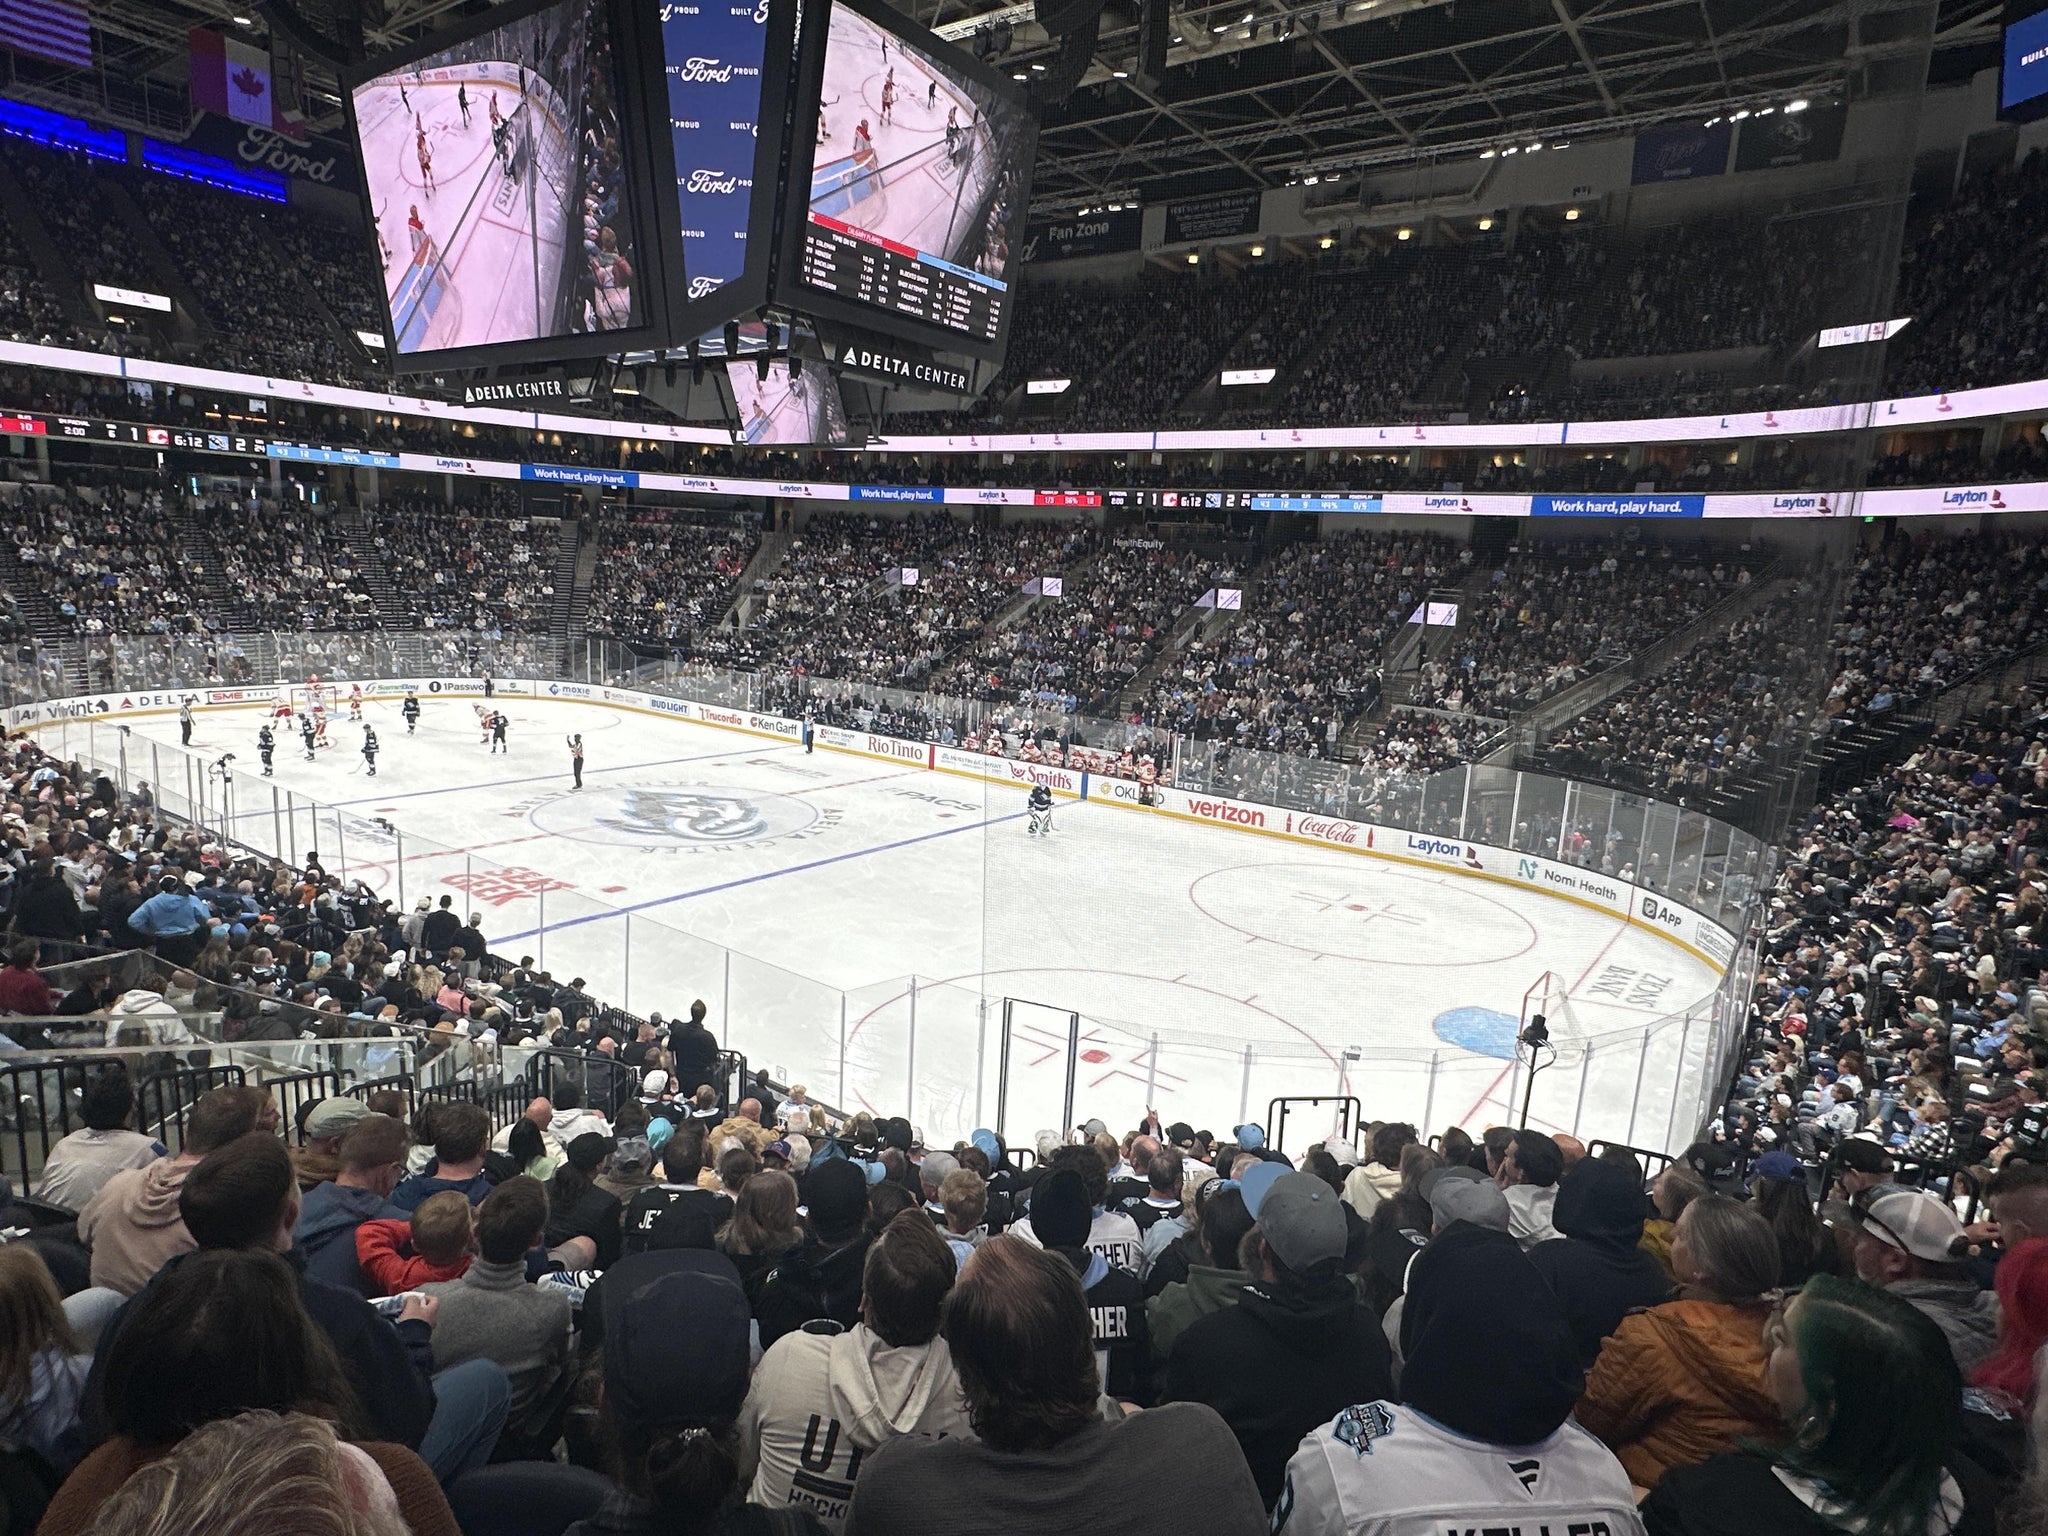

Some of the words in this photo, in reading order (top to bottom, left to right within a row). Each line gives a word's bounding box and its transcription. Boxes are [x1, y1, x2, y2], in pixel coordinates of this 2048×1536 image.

[674, 6, 699, 14] PROUD
[730, 7, 751, 16] BUILT
[681, 57, 732, 83] Ford
[734, 68, 758, 76] PROUD
[675, 121, 700, 129] PROUD
[730, 122, 750, 130] BUILT
[238, 125, 336, 182] Ford
[687, 169, 736, 194] Ford
[682, 230, 705, 239] PROUD
[1049, 227, 1074, 241] Fan
[1076, 222, 1109, 237] Zone
[860, 351, 910, 376] DELTA
[915, 364, 966, 389] CENTER
[476, 384, 514, 400] DELTA
[516, 380, 562, 398] CENTER
[174, 436, 203, 448] 6:12
[236, 438, 246, 452] 2
[436, 458, 464, 468] Layton
[534, 468, 558, 478] Work
[560, 470, 582, 482] hard,
[584, 472, 602, 484] play
[603, 474, 626, 484] hard.
[682, 479, 708, 488] Layton
[779, 484, 803, 494] Layton
[860, 488, 879, 498] Work
[880, 489, 900, 500] hard,
[900, 490, 915, 501] play
[916, 490, 934, 500] hard.
[978, 490, 1000, 500] Layton
[1181, 496, 1202, 508] 6:12
[1226, 494, 1235, 507] 2
[1425, 496, 1458, 508] Layton
[1773, 496, 1815, 510] Layton
[1943, 489, 1988, 506] Layton
[1552, 500, 1584, 512] Work
[1586, 500, 1619, 514] hard,
[1620, 500, 1644, 516] play
[1646, 500, 1682, 513] hard.
[444, 682, 495, 691] 1Passwod
[562, 686, 590, 695] moxie
[140, 693, 200, 706] DELTA
[212, 692, 244, 701] SME
[651, 699, 666, 709] BUD
[667, 702, 689, 714] LIGHT
[705, 709, 742, 726] Trucordia
[758, 718, 774, 732] Ken
[776, 721, 797, 736] Garff
[868, 736, 889, 754] Rio
[890, 740, 922, 760] Tinto
[1027, 766, 1072, 790] Smith's
[1114, 785, 1165, 804] OKLD
[1188, 798, 1264, 828] verizon
[785, 814, 844, 839] DELTA
[640, 840, 776, 854] CENTER
[1408, 834, 1460, 857] Layton
[440, 874, 537, 906] GEEK
[1544, 870, 1576, 888] Nomi
[1579, 878, 1617, 900] Health
[1658, 906, 1682, 928] App
[1587, 964, 1637, 998] BANK
[1626, 972, 1674, 1008] ZIONS
[2022, 1118, 2039, 1132] 92
